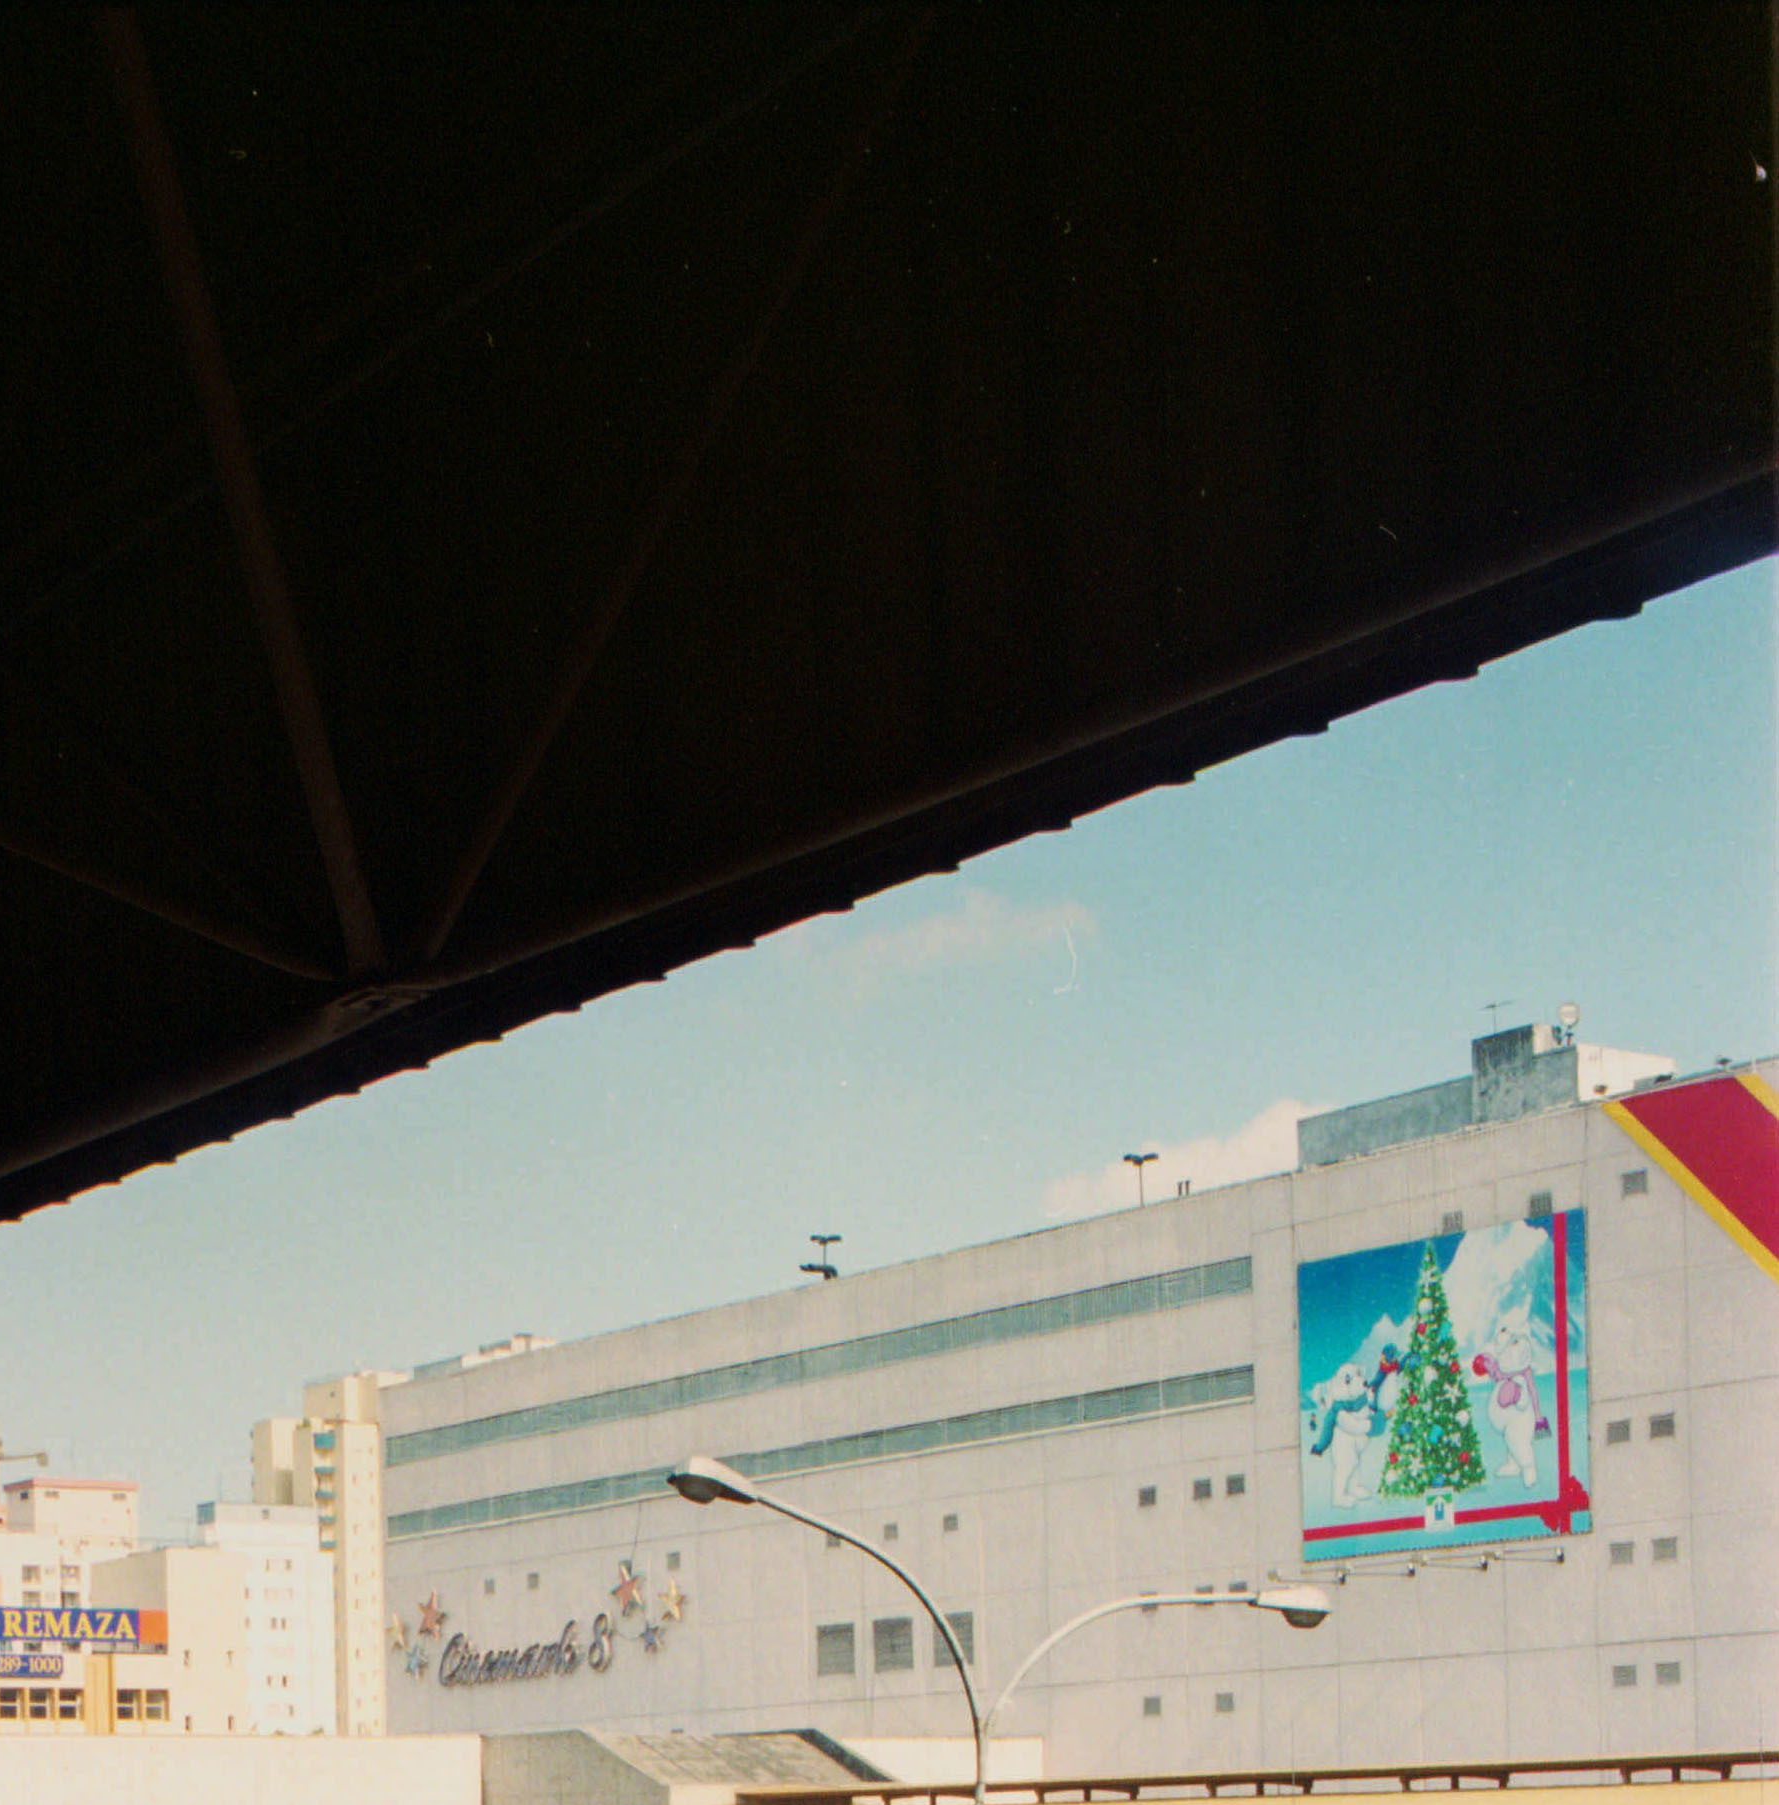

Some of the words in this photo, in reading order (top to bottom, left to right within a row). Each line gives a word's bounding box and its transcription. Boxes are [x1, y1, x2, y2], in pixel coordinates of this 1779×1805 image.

[2, 1610, 137, 1640] REMAZA
[438, 1619, 580, 1687] Cinemark
[588, 1612, 614, 1672] 8
